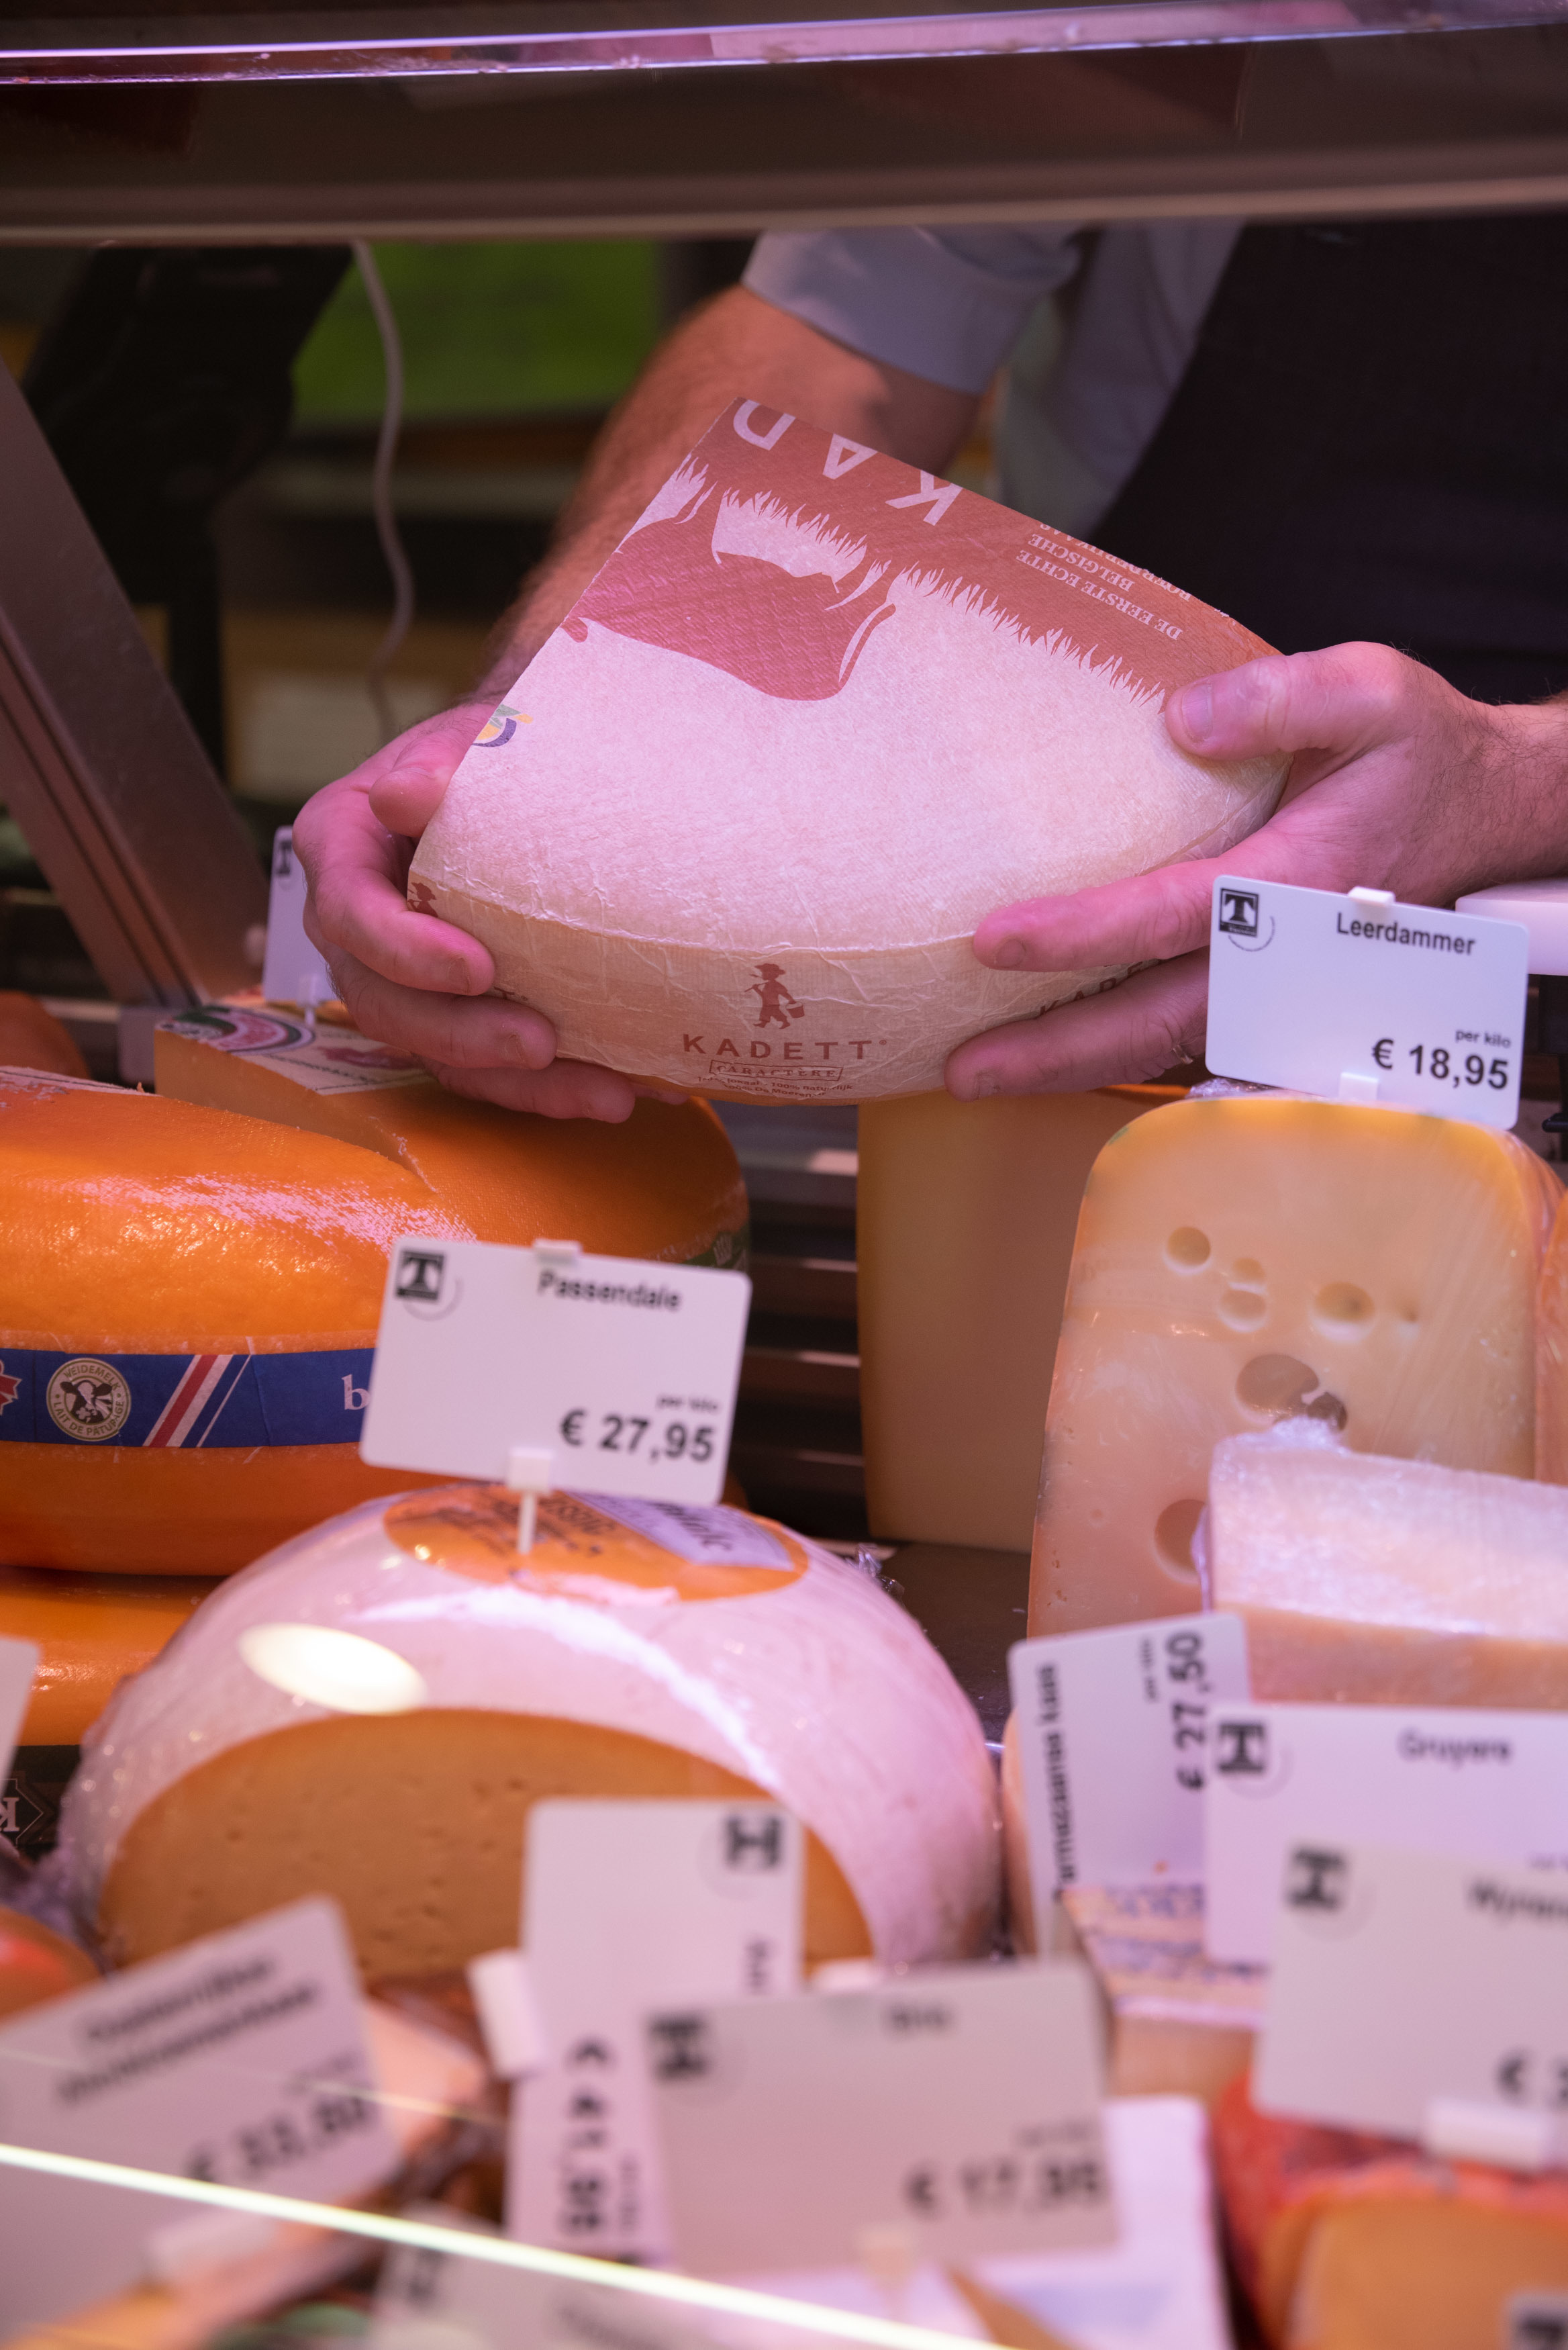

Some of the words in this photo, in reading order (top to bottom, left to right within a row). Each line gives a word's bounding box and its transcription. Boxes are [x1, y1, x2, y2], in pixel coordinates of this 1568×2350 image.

[1016, 550, 1081, 588] ECHTE
[1027, 533, 1136, 592] BELGISCHE
[1081, 581, 1155, 625] EERSTE
[1154, 618, 1183, 641] DE
[1337, 912, 1475, 955] Leerdammer
[682, 1033, 873, 1060] KADETT
[1455, 1029, 1479, 1043] per
[1483, 1031, 1511, 1048] kilo
[716, 1066, 837, 1078] CARACTÈRE
[1372, 1039, 1394, 1070] €
[1409, 1045, 1510, 1090] 18,95
[537, 1271, 680, 1311] Passendale
[64, 1364, 121, 1391] WEIDEMELK
[54, 1402, 70, 1423] LAIT
[68, 1421, 85, 1434] DE
[559, 1409, 586, 1446] €
[599, 1413, 715, 1464] 27,95
[1165, 1632, 1212, 1750] 27,50
